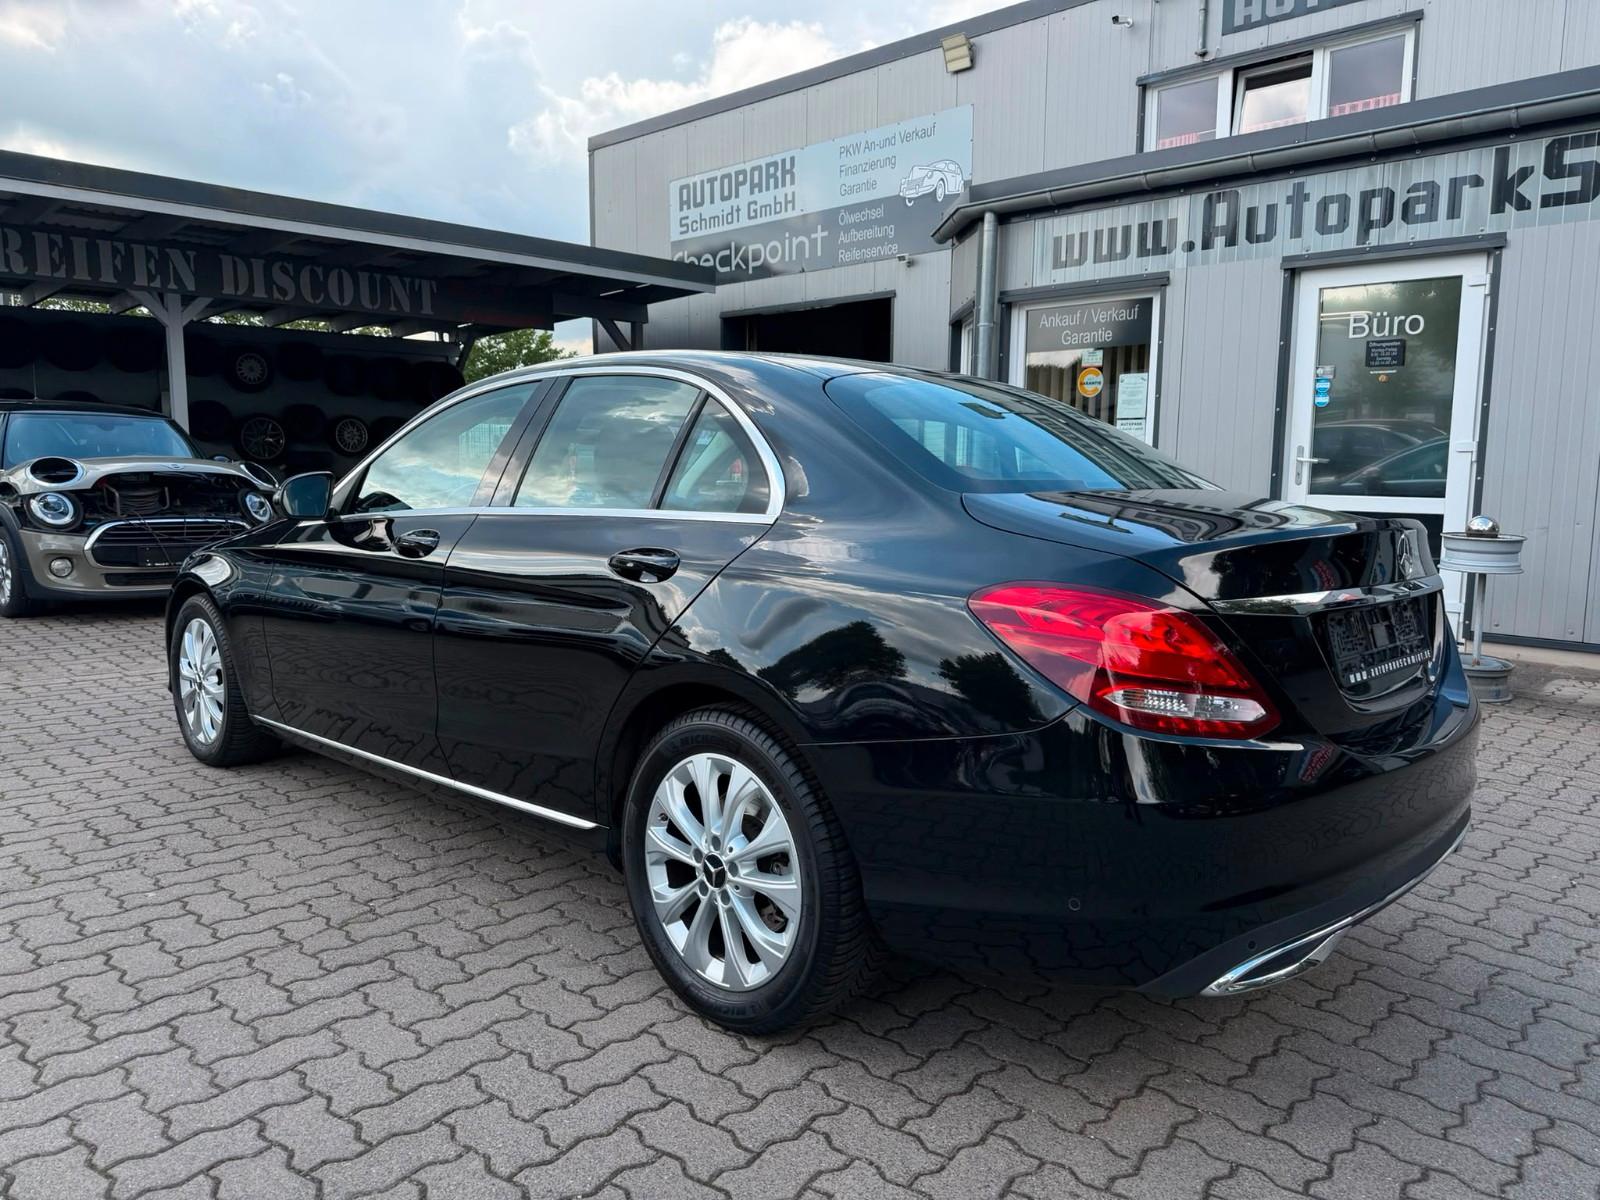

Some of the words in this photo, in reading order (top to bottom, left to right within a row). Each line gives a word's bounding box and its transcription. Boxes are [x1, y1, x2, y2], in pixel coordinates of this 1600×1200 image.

[839, 141, 862, 160] PKW
[863, 135, 896, 153] An-und
[898, 122, 936, 145] Verkauf
[839, 155, 896, 178] Finanzierung
[679, 155, 795, 212] AUTOPARK
[839, 178, 878, 197] Garantie
[679, 204, 741, 234] Schmidt
[747, 191, 795, 220] GmbH
[838, 204, 884, 226] Ölwechsel
[838, 224, 895, 244] Aufbereitung
[838, 242, 898, 263] Reifenservice
[0, 227, 197, 293] REIFEN
[219, 253, 437, 316] DISCOUNT
[1039, 310, 1082, 329] Ankauf
[1091, 304, 1140, 324] Verkauf
[1348, 311, 1425, 339] Büro
[1061, 327, 1113, 346] Garantie
